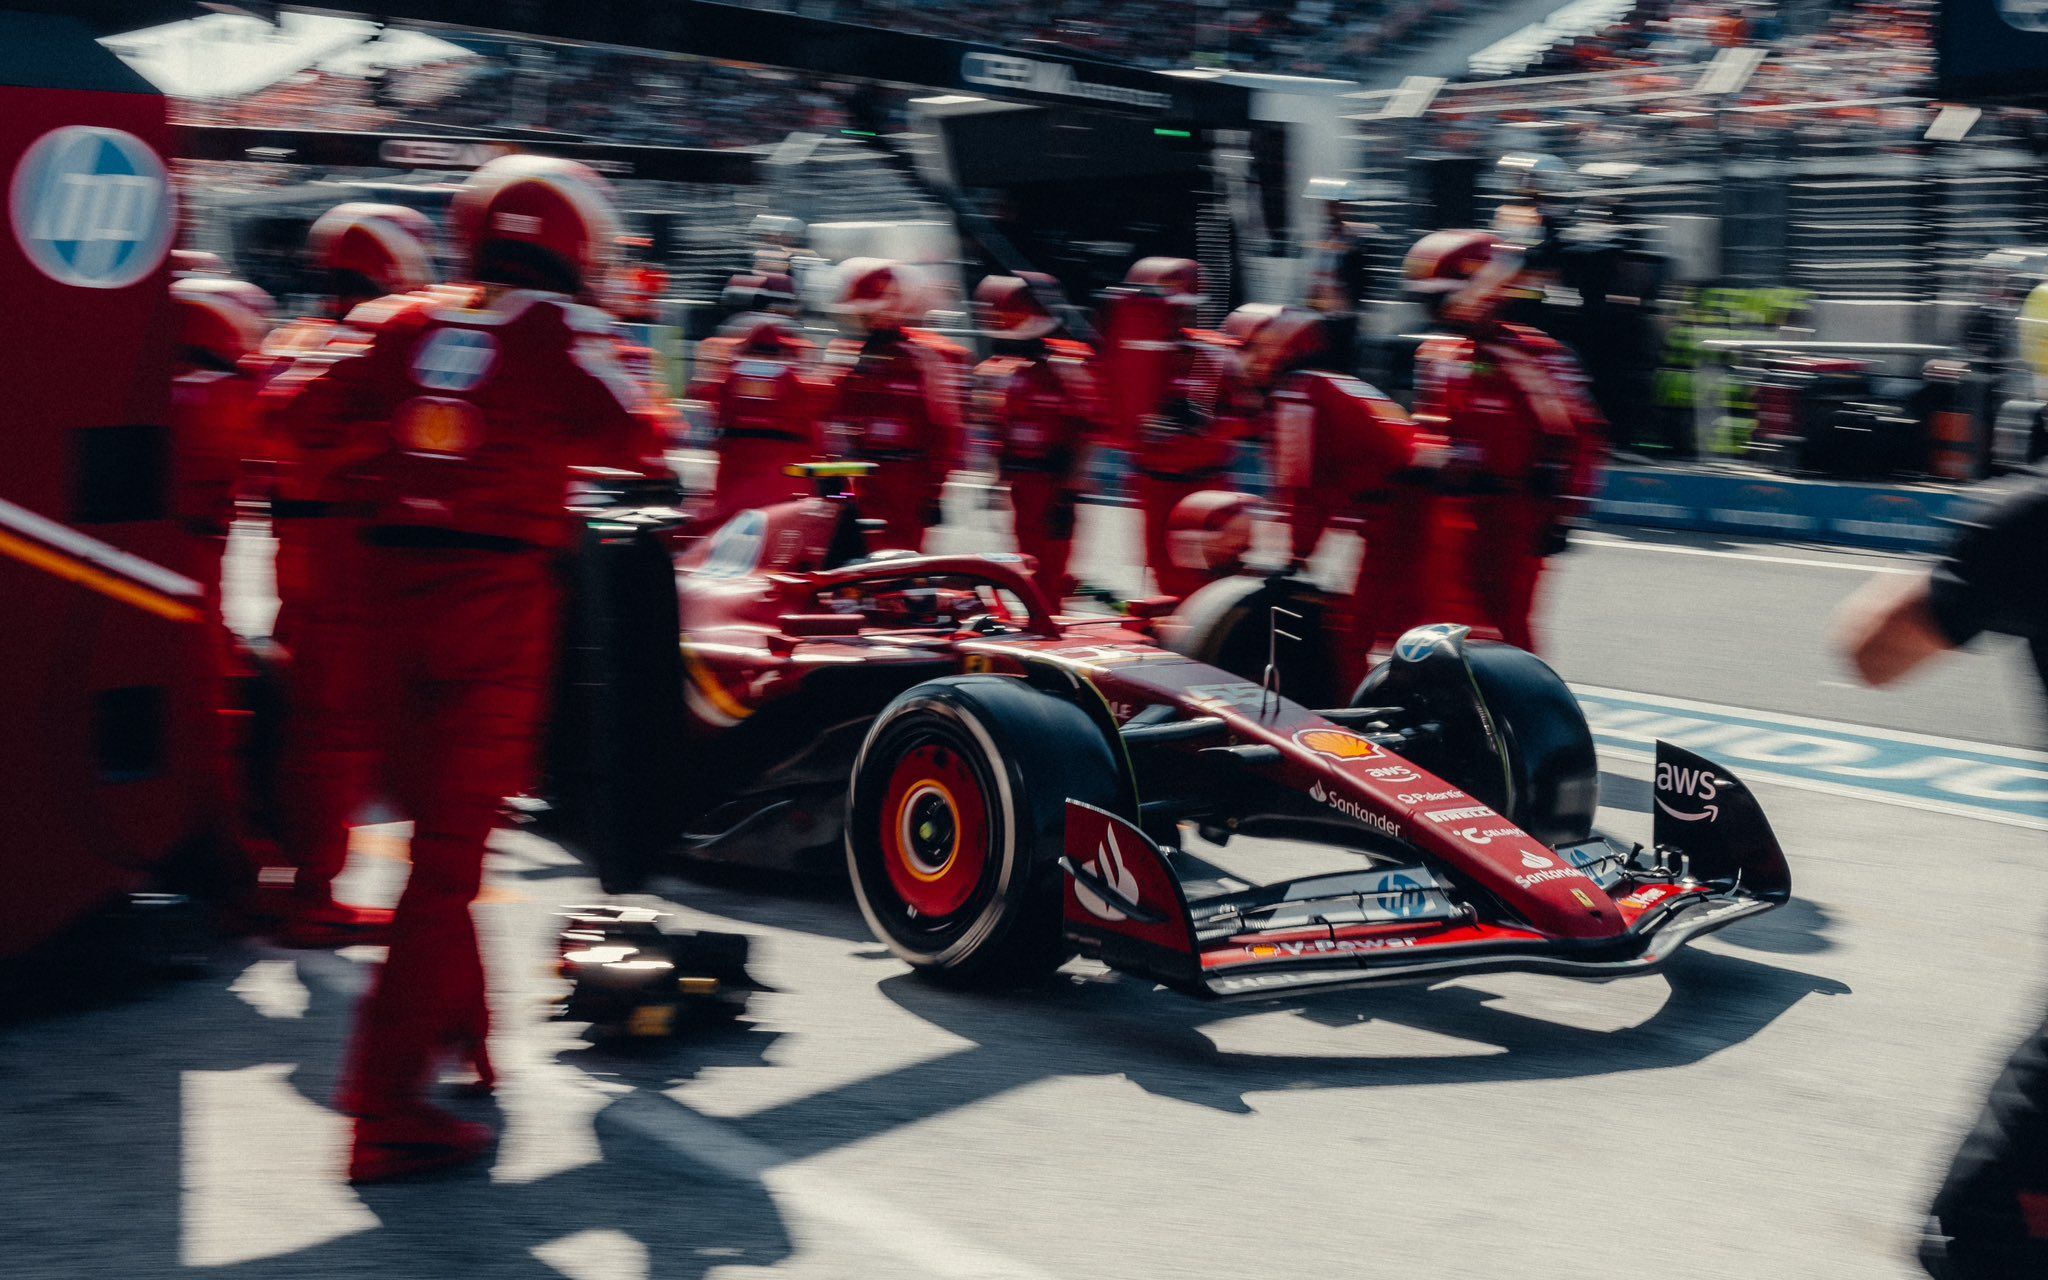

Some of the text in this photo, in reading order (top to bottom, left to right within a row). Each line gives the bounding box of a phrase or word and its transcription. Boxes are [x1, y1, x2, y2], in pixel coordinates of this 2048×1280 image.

[1365, 765, 1411, 779] aws
[1656, 762, 1716, 800] aws
[1328, 790, 1401, 837] Santander
[1384, 872, 1424, 917] hp
